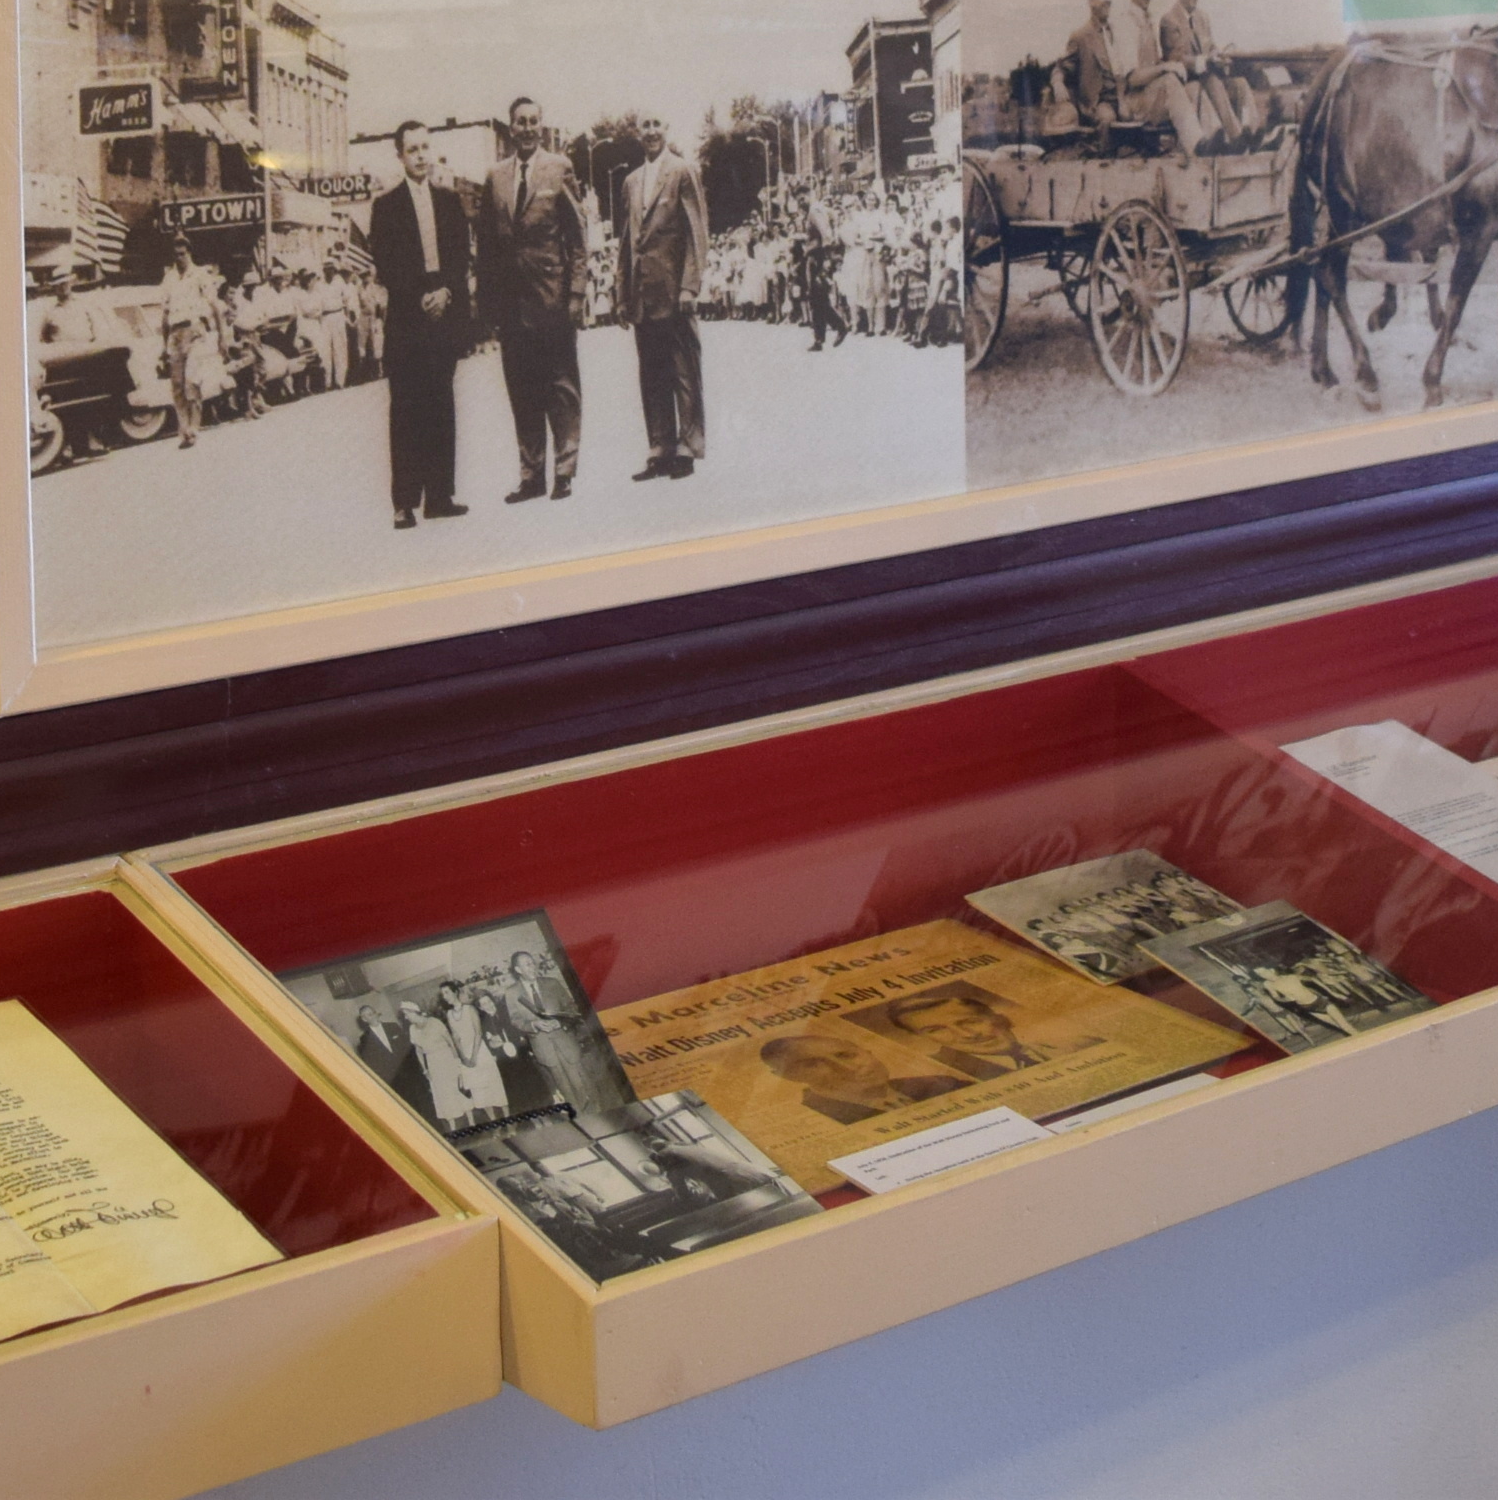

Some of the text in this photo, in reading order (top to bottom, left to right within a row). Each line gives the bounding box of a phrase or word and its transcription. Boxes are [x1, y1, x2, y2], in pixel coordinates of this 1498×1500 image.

[619, 952, 1001, 1067] Walt Disney Accepts July 4 Invitation
[631, 945, 912, 1028] Marceline News
